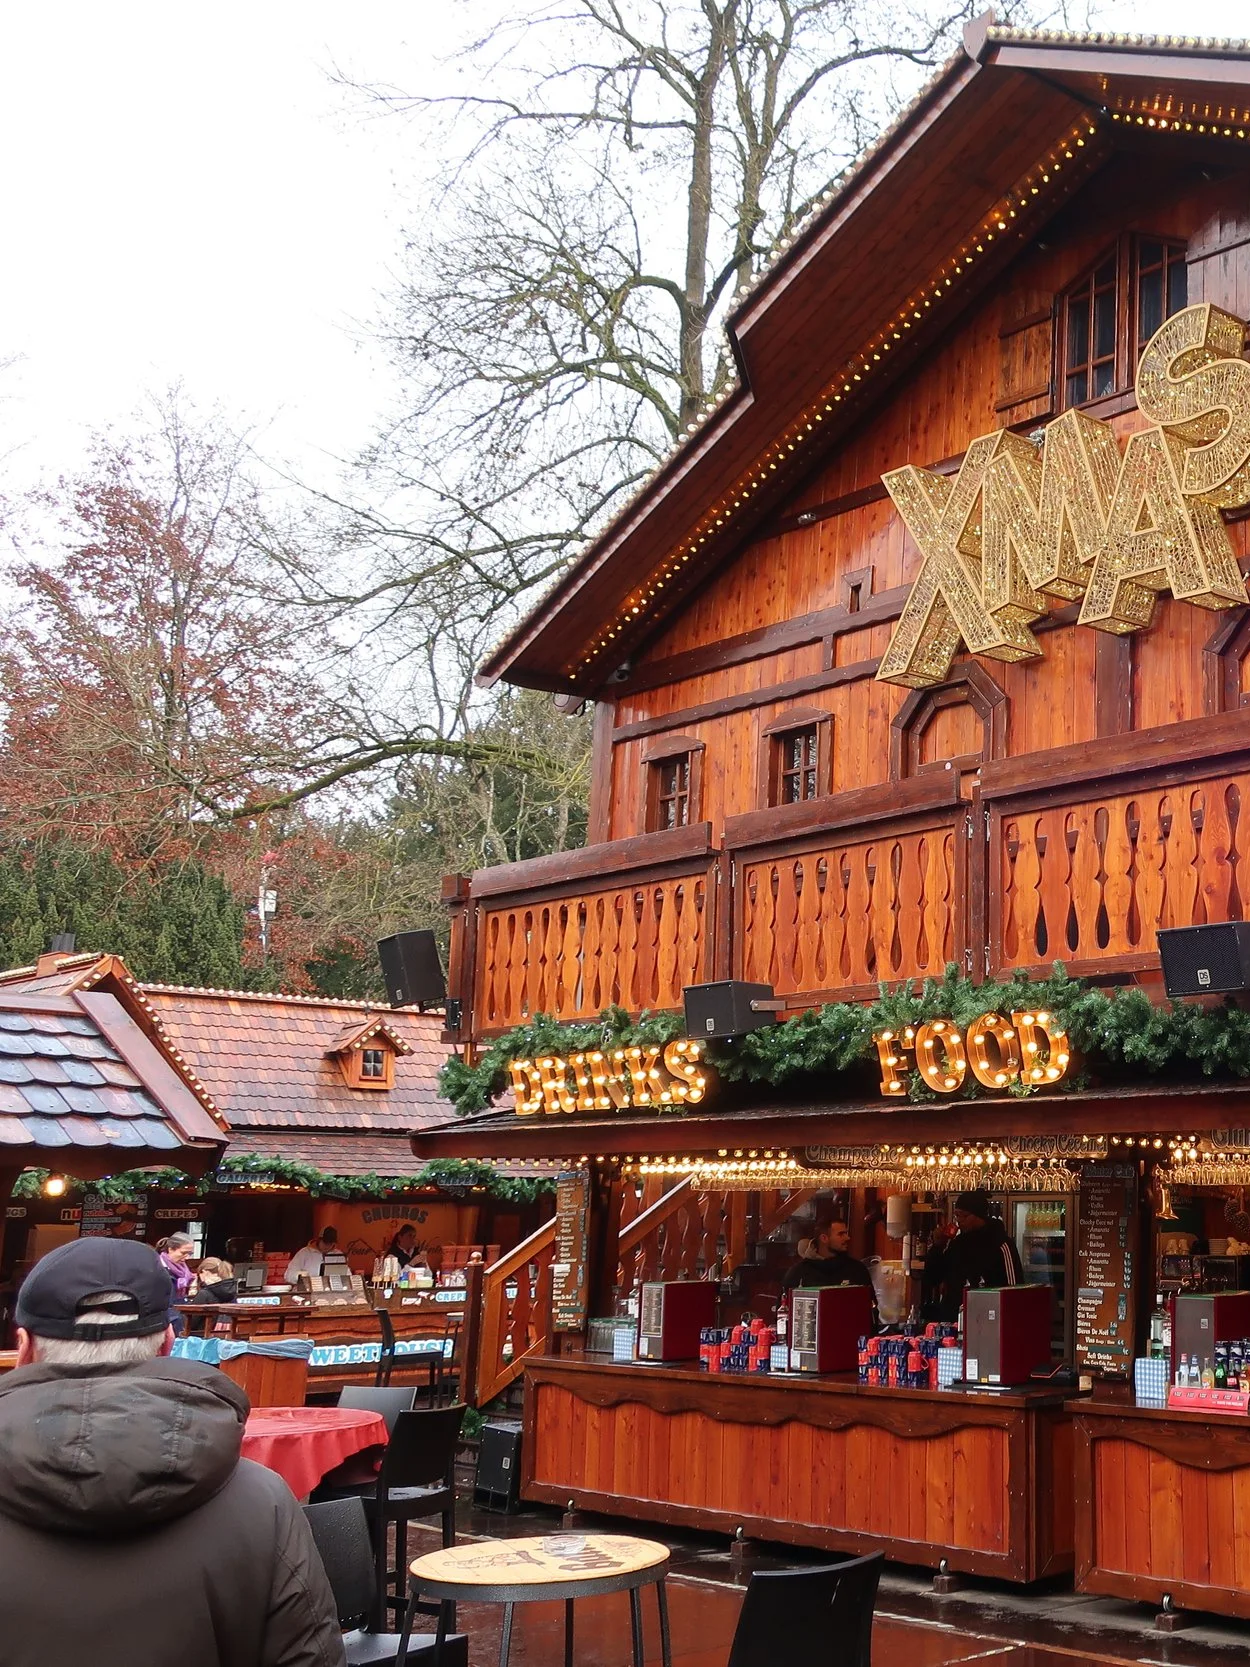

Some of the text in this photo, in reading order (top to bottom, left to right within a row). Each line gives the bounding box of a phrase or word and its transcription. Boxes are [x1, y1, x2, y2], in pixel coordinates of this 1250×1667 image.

[509, 1040, 706, 1115] DRINKS
[872, 1012, 1070, 1096] FOOD
[155, 1209, 198, 1219] CREPES
[362, 1205, 428, 1224] CHURROS
